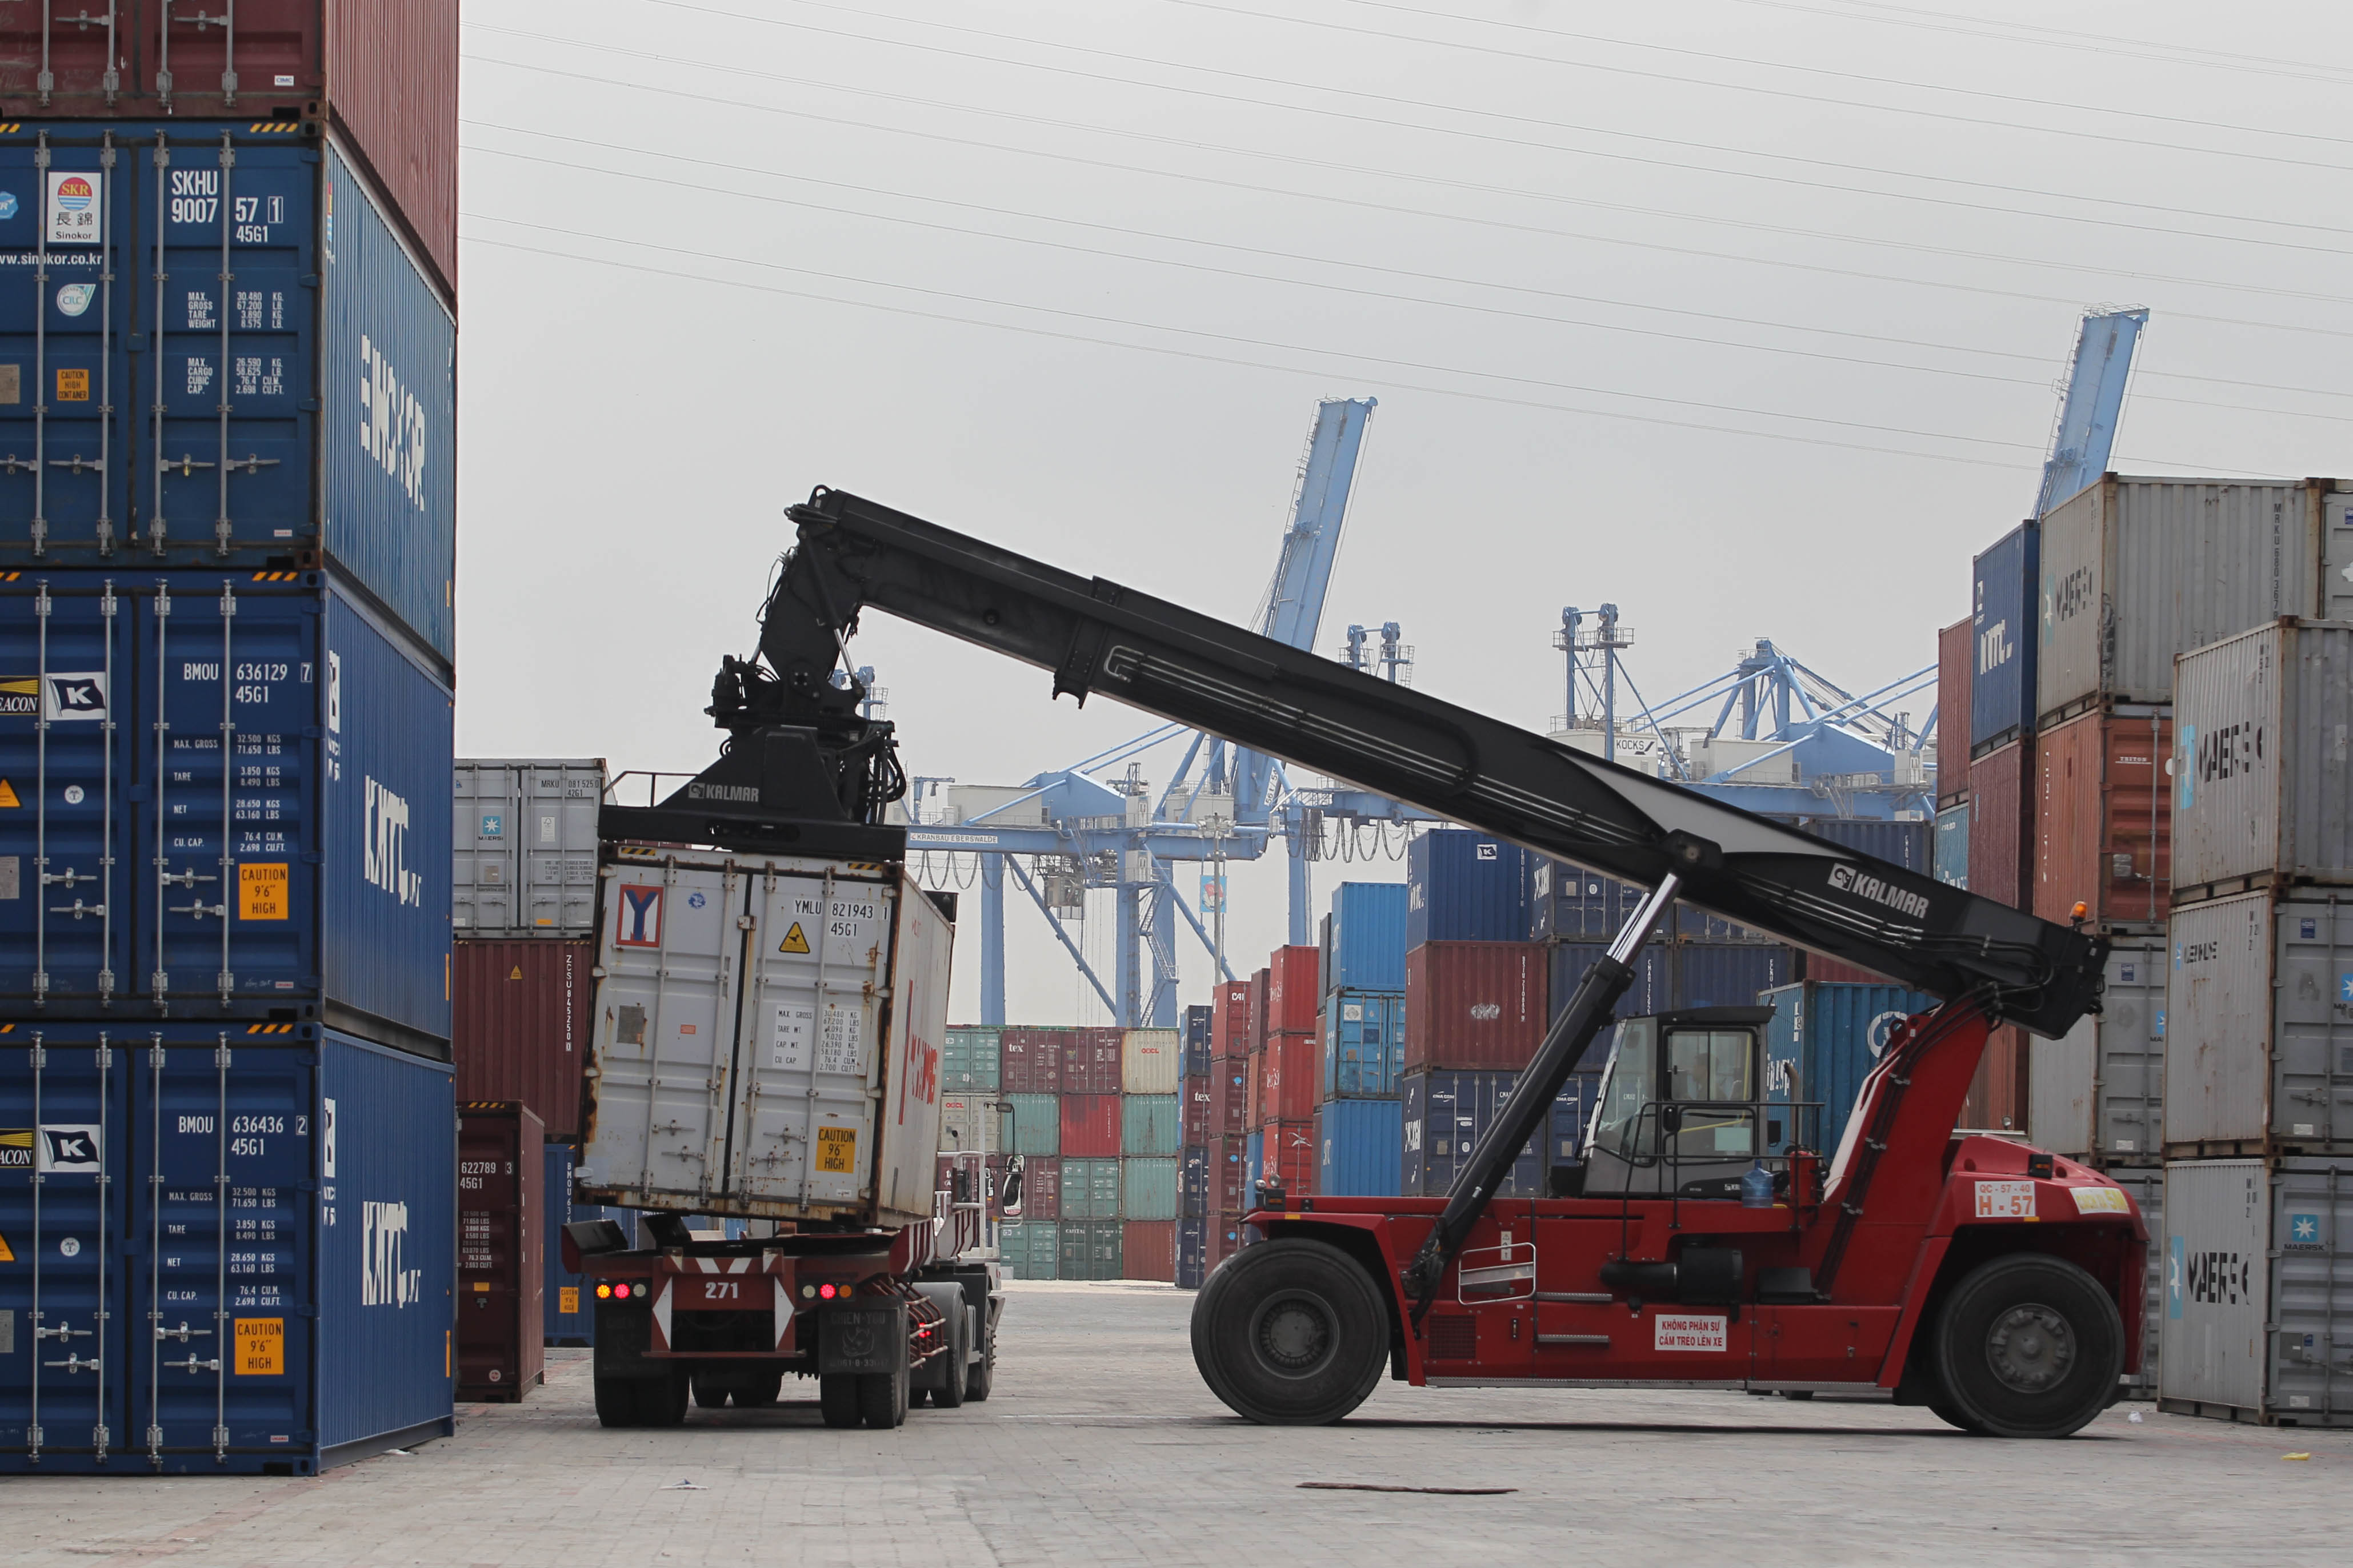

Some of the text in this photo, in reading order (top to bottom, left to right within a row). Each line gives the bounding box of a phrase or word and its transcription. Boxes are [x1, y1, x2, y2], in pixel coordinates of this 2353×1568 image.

[171, 171, 218, 195] SKHU
[61, 184, 89, 195] SKR
[171, 198, 218, 223] 9007
[235, 197, 258, 223] 57
[236, 226, 268, 243] 45G1
[0, 252, 102, 265] w.sinkor.co.kr
[188, 292, 208, 300] MAX.
[237, 292, 262, 301] 30.480
[188, 310, 207, 319] TARE
[188, 319, 216, 328] WEIGHT
[241, 319, 262, 328] 8.575
[188, 358, 208, 367] MAX.
[236, 358, 262, 367] 26.590
[61, 370, 85, 379] CAUTION
[188, 367, 213, 376] CARGO
[236, 367, 261, 376] 58.625
[188, 376, 209, 386] CUBIC
[241, 376, 257, 385] 76.4
[188, 386, 257, 394] CAP. 2.698
[58, 391, 87, 400] CONTAINER
[183, 663, 219, 680] BMOU
[237, 663, 287, 681] 636129
[235, 685, 269, 703] 45G1
[174, 739, 218, 749] MAX. GROSS
[237, 735, 281, 743] 32.500 KGS
[1616, 739, 1645, 750] KOCKS
[237, 745, 281, 755] 71.650 LBS
[174, 772, 191, 781] TARE
[241, 767, 280, 776] 3.850 KGS
[241, 778, 280, 787] 8.490 LBS
[706, 787, 759, 803] KALMAR
[236, 799, 280, 808] 28.650 KGS
[174, 805, 187, 814] NET
[235, 811, 279, 820] 63.160 LBS
[245, 832, 261, 841] 76.4
[917, 833, 997, 844] KRANBAU EBERSWALDE
[174, 838, 205, 847] CU. CAP.
[240, 843, 261, 852] 2.698
[242, 869, 286, 881] CAUTION
[1852, 873, 1930, 918] KALMAR
[252, 902, 277, 914] HIGH
[795, 900, 888, 920] YMLU 821943 1
[830, 922, 857, 937] 45G1
[1231, 992, 1244, 1001] CAI
[796, 1011, 813, 1020] GROSS
[1009, 1043, 1024, 1052] tex
[1194, 1092, 1211, 1102] tex
[178, 1116, 214, 1134] BMOU
[233, 1116, 284, 1134] 636436
[818, 1129, 855, 1143] CAUTION
[231, 1138, 265, 1156] 45G1
[461, 1162, 496, 1174] 622789
[825, 1156, 845, 1170] HIGH
[460, 1177, 482, 1189] 45G1
[232, 1188, 276, 1196] 32.500 KGS
[1979, 1184, 2030, 1194] QC 57 40
[169, 1192, 213, 1202] MAX. GROSS
[232, 1198, 275, 1208] 71.650 LBS
[1979, 1196, 2032, 1215] H 57
[705, 1282, 738, 1298] 271
[238, 1324, 282, 1336] CAUTION
[1662, 1318, 1687, 1330] KHÔNG
[1688, 1319, 1708, 1334] PHẬN
[1659, 1332, 1723, 1347] CẤM TRÈO LÊN XE
[247, 1357, 272, 1369] HIGH
